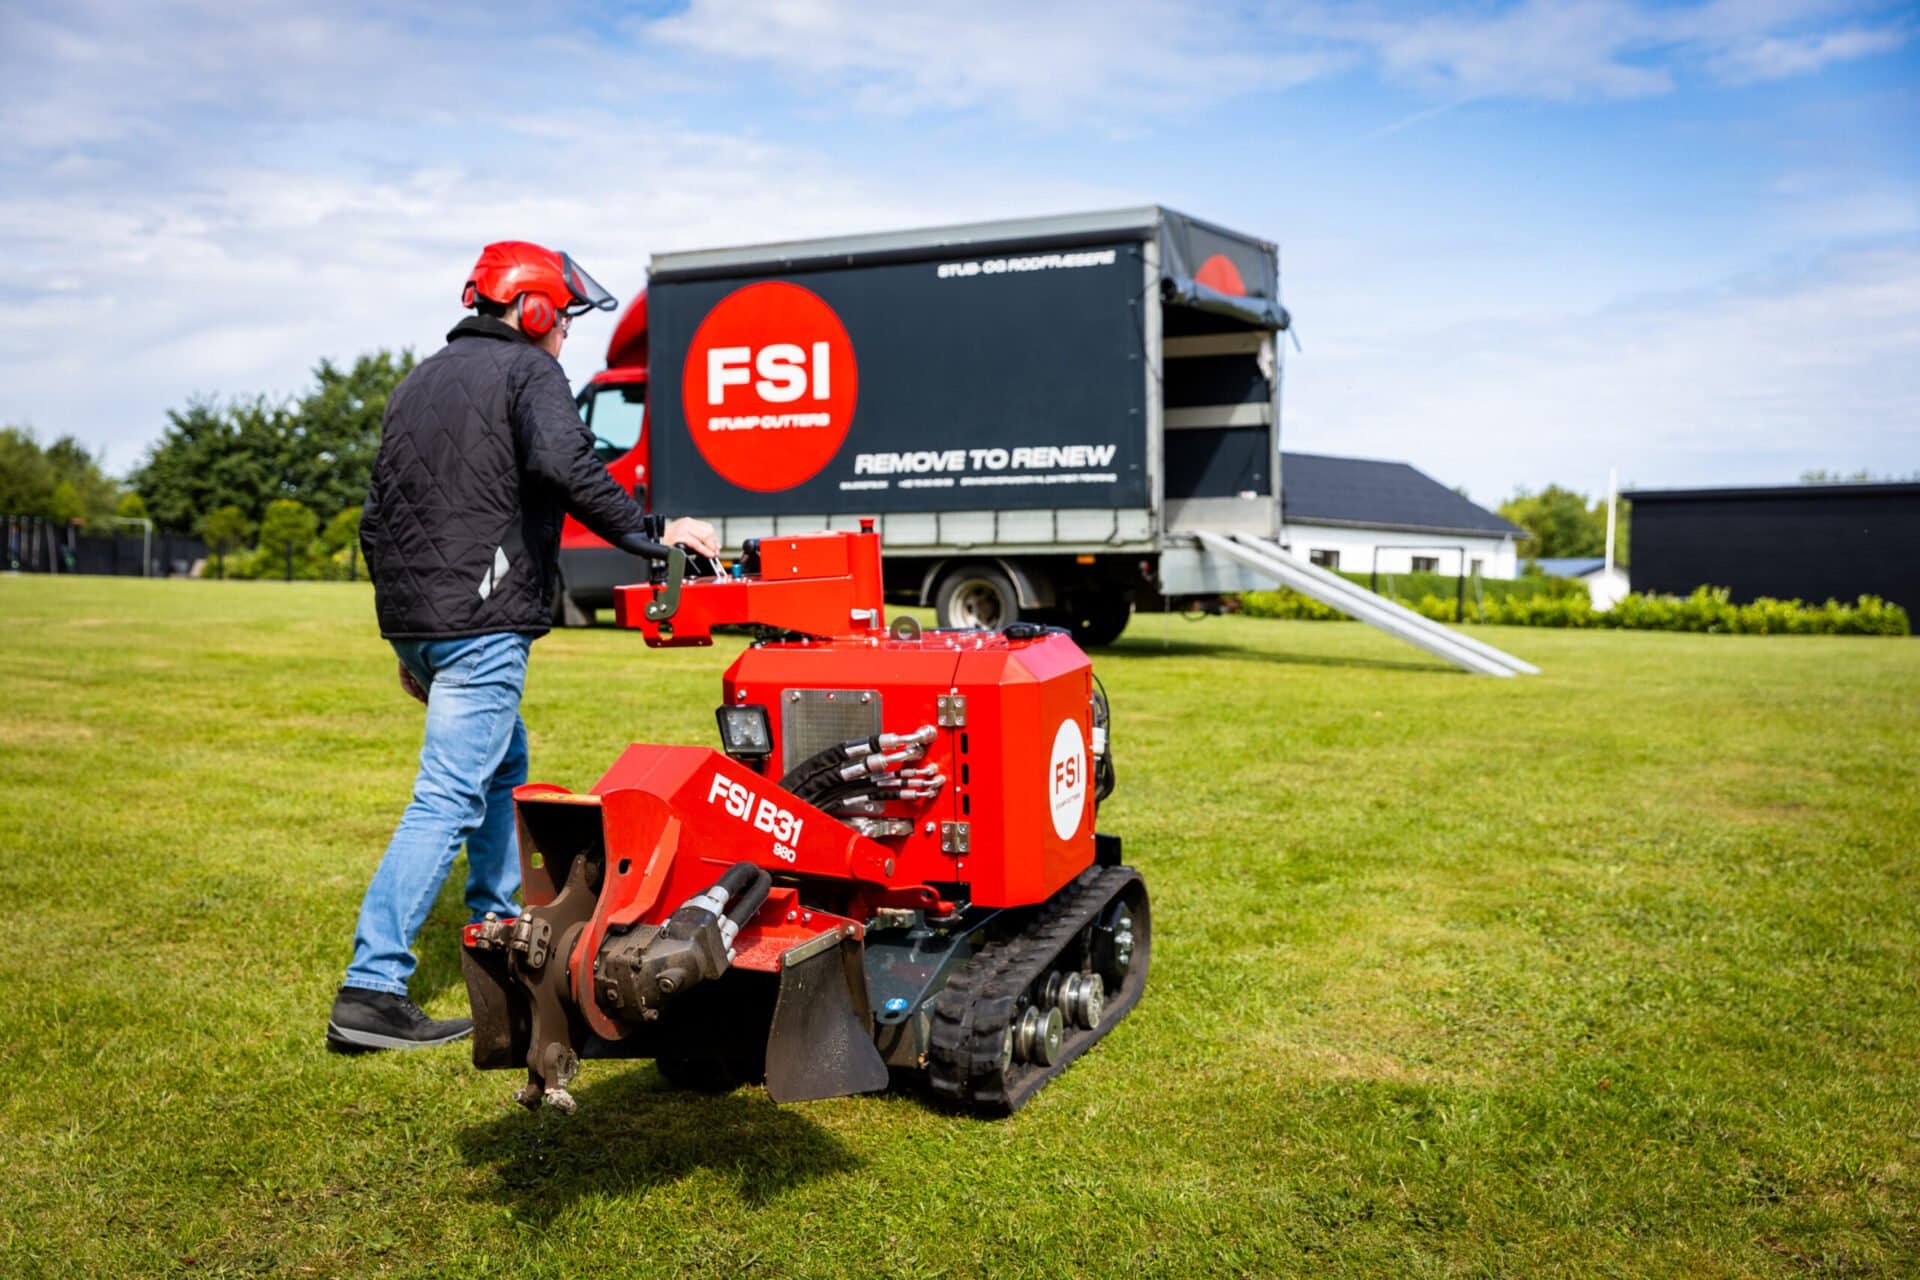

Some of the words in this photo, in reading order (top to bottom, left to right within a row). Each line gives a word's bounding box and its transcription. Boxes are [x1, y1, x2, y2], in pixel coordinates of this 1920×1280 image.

[982, 259, 1007, 274] OG
[707, 341, 830, 406] FSI
[708, 414, 759, 431] STUMP
[760, 412, 830, 430] CUTTERS
[854, 448, 965, 475] REMOVE
[968, 447, 1009, 471] TO
[1011, 444, 1117, 469] RENEW
[1055, 753, 1080, 794] FSI
[707, 772, 756, 822] FSI
[753, 797, 804, 848] B31
